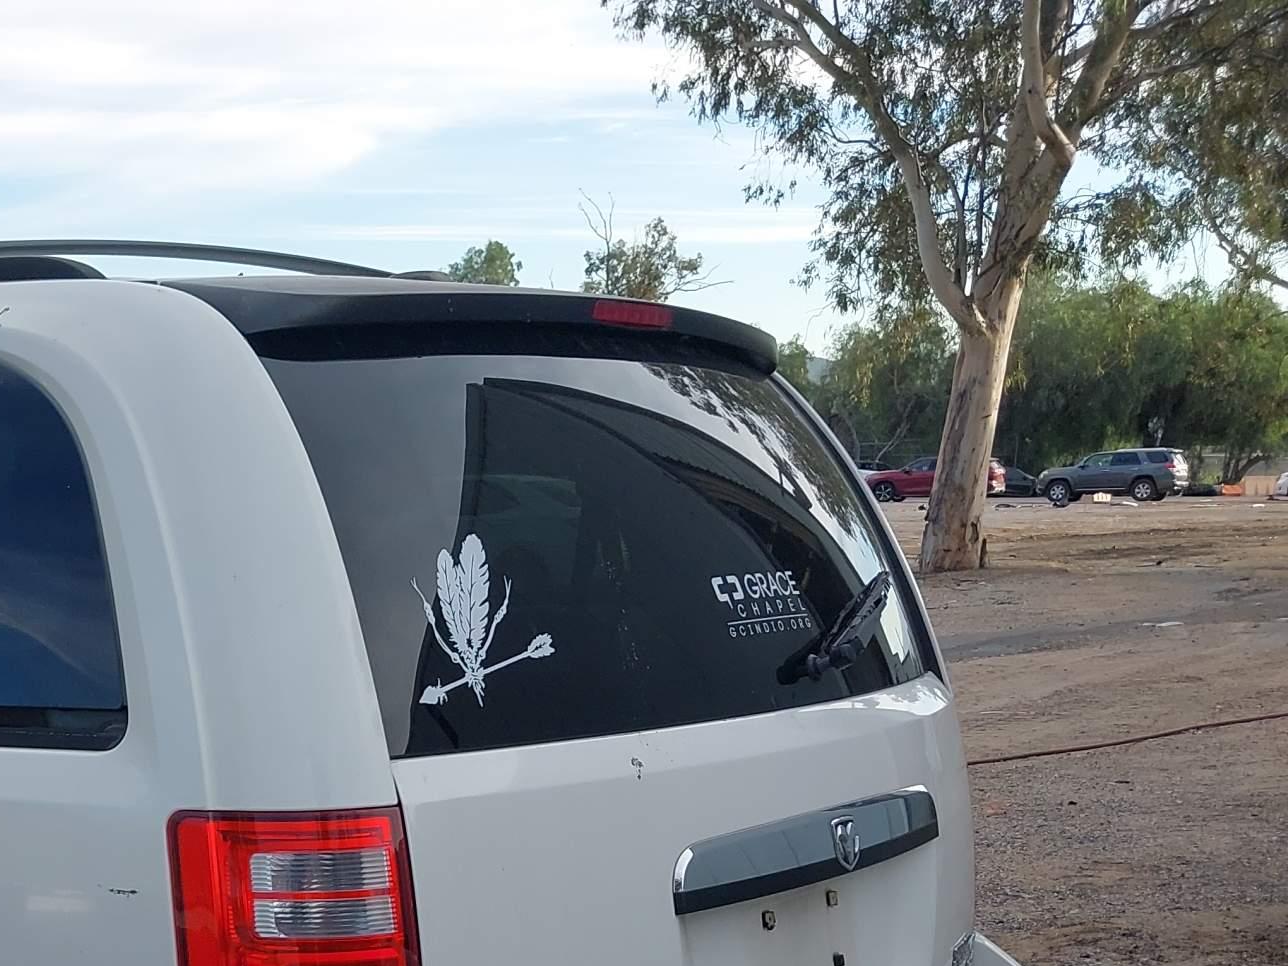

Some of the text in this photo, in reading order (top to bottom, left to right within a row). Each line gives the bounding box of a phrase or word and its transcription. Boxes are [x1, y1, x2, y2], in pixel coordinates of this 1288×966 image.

[743, 570, 800, 599] GRACE
[737, 597, 807, 618] CHAPEL
[729, 617, 812, 638] GCINDIO.ORG
